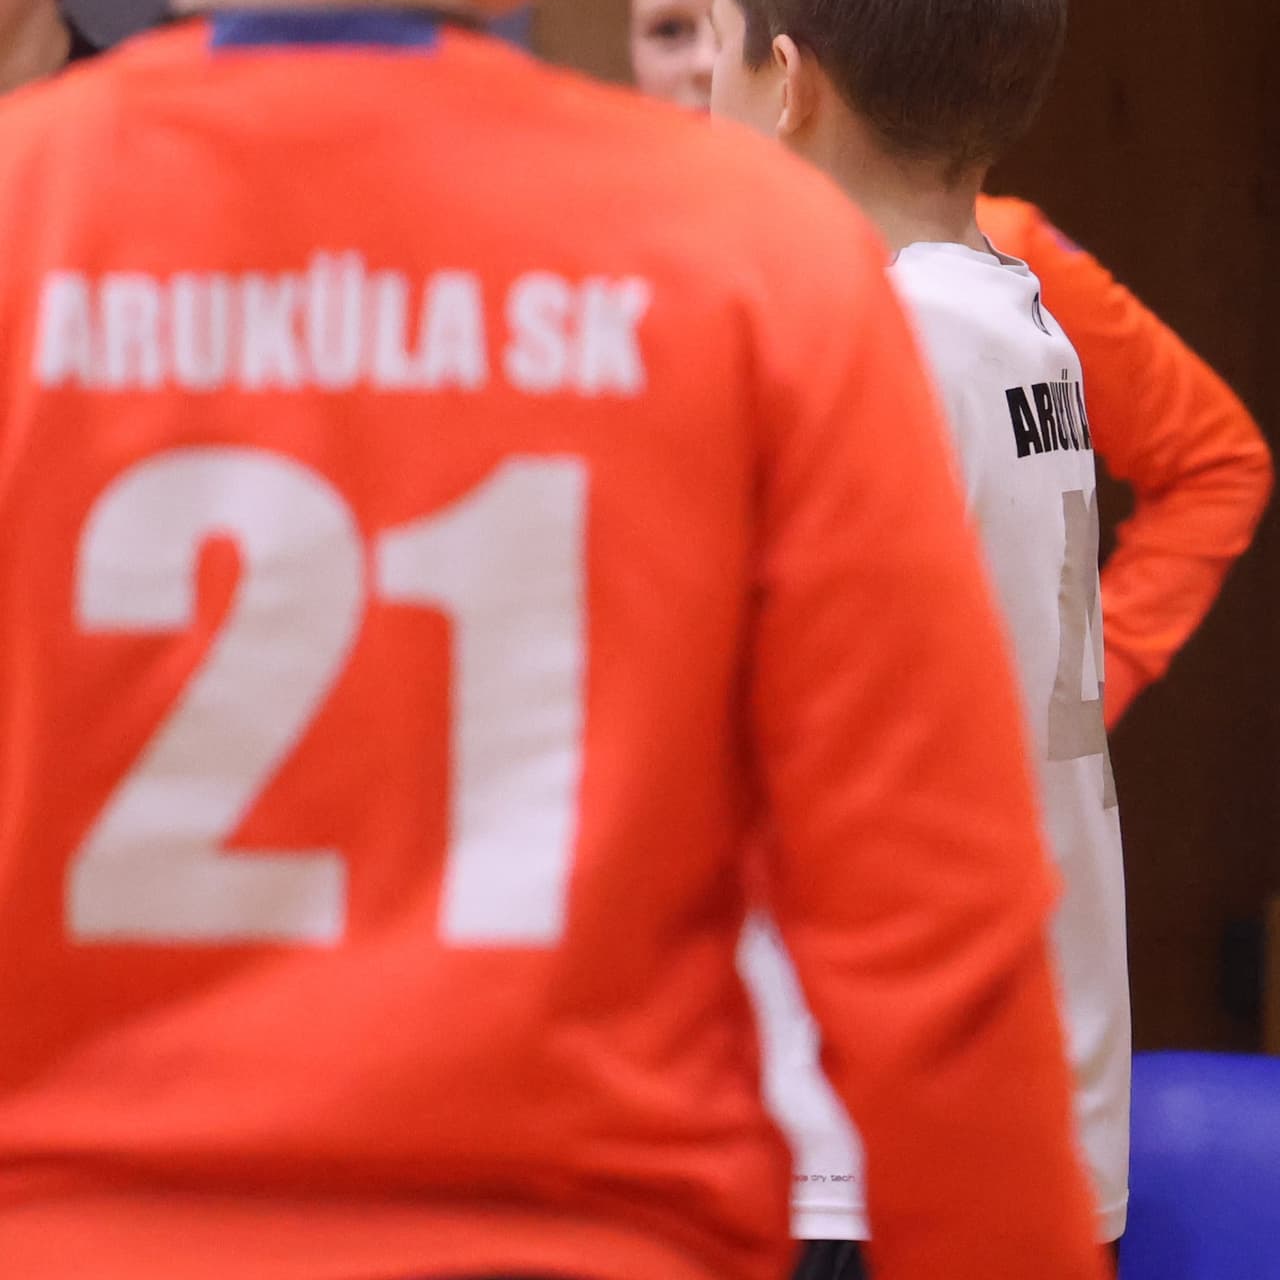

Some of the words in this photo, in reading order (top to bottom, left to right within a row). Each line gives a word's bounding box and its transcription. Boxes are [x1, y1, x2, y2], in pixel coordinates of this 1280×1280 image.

[36, 250, 488, 392] ARUKÜLA
[502, 271, 650, 395] SK
[64, 444, 588, 948] 21
